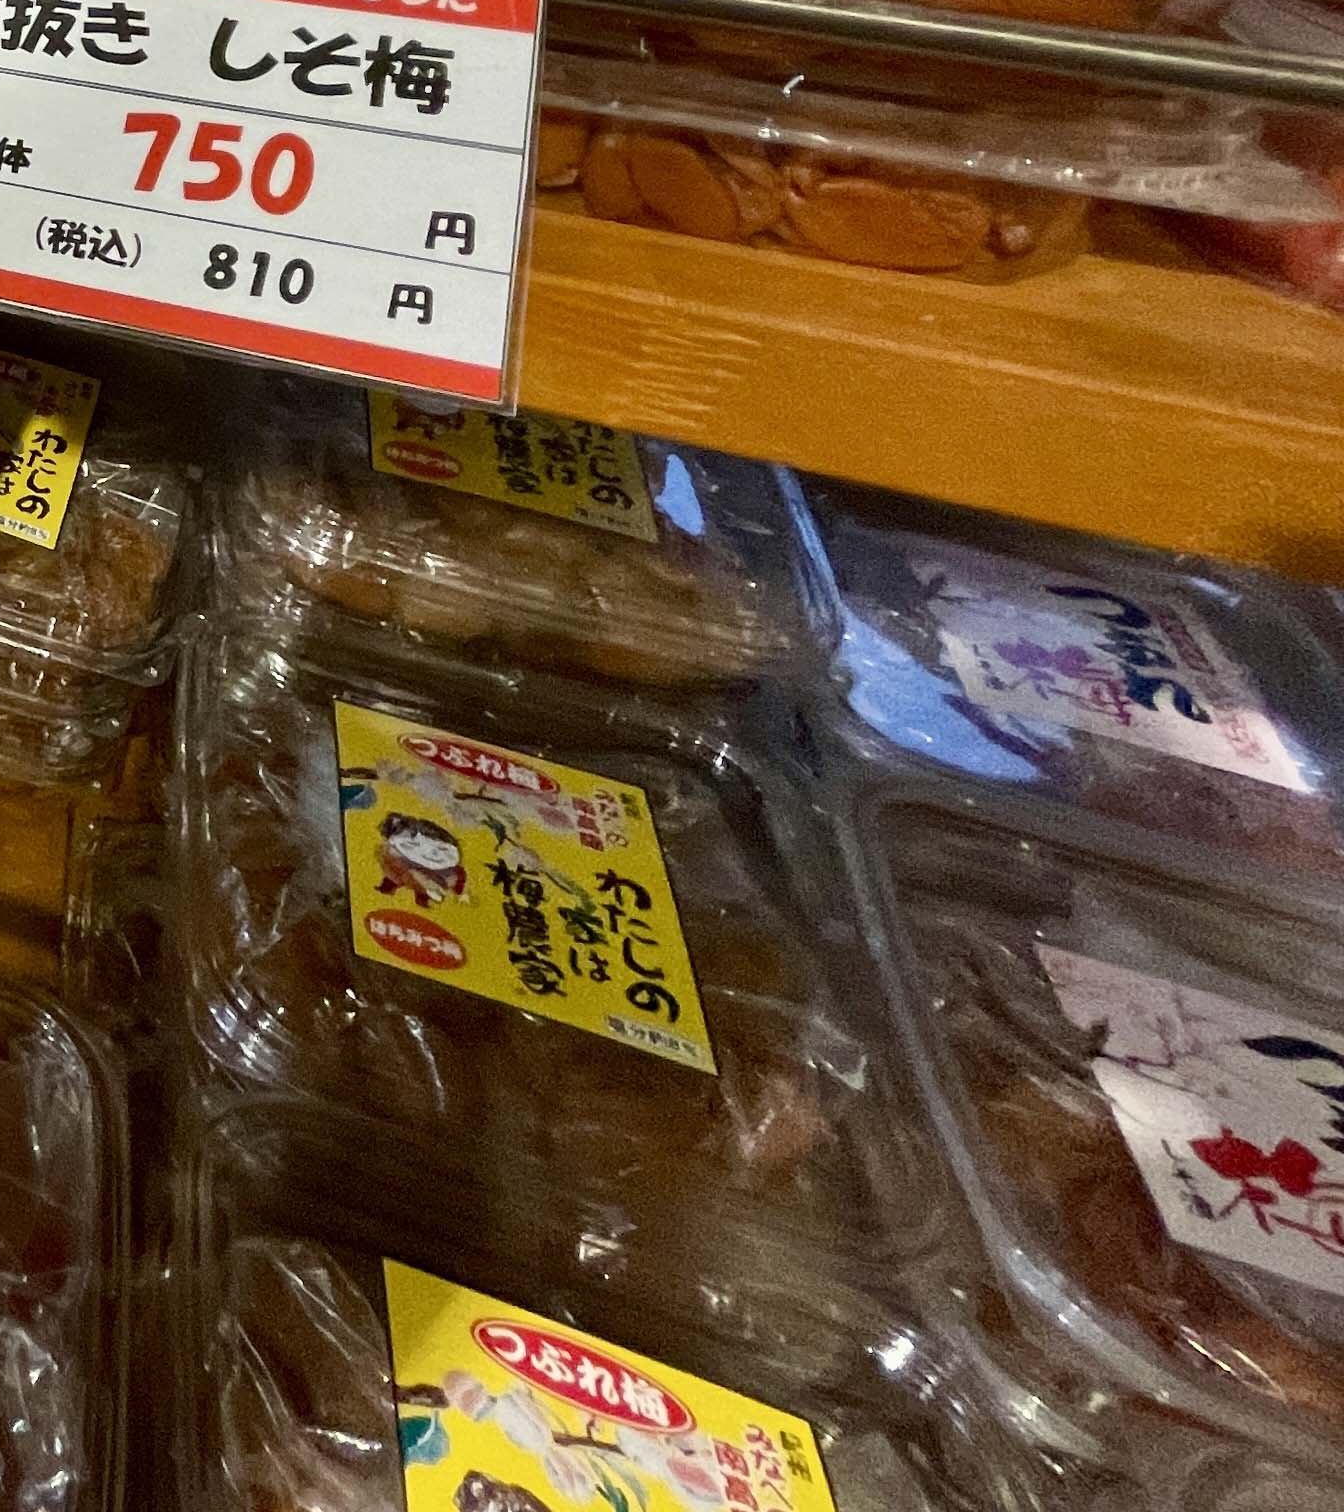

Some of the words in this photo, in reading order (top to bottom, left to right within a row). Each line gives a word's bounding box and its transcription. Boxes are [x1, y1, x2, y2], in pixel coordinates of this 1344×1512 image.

[209, 16, 455, 116] しそ梅
[122, 111, 314, 216] 750
[425, 211, 477, 256] 円
[34, 216, 143, 269] (税込)
[202, 243, 314, 305] 810
[387, 283, 434, 325] 円
[16, 428, 68, 520] わたしの
[408, 736, 542, 793] つぶれ梅
[594, 868, 681, 1024] わたしの
[486, 1326, 673, 1428] つぶれ梅
